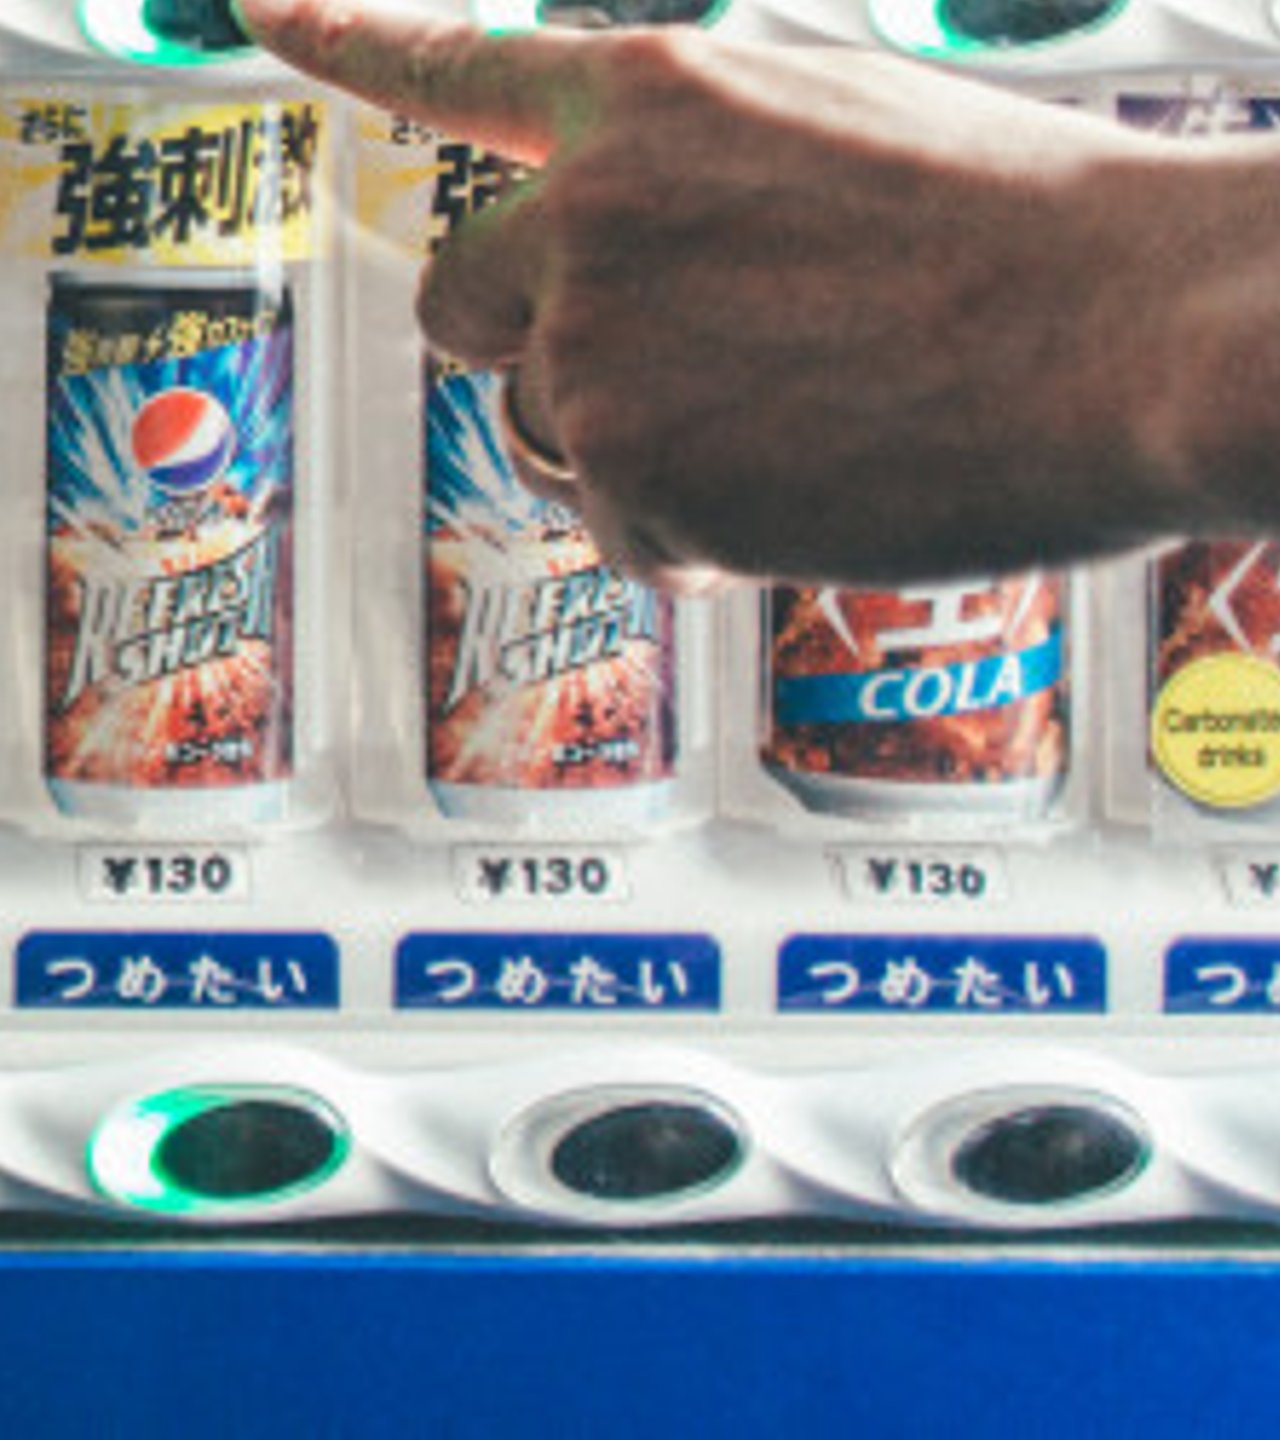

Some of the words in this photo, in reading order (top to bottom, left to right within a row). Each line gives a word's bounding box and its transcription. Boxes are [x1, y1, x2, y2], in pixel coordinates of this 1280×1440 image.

[857, 652, 1025, 720] COLA
[1165, 707, 1280, 734] Carbonate
[104, 857, 232, 893] ¥130
[477, 857, 608, 894] ¥130
[867, 858, 987, 896] ¥130
[46, 955, 307, 1003] つめたい
[425, 955, 688, 1003] つめたい
[808, 957, 1075, 1004] つめたい
